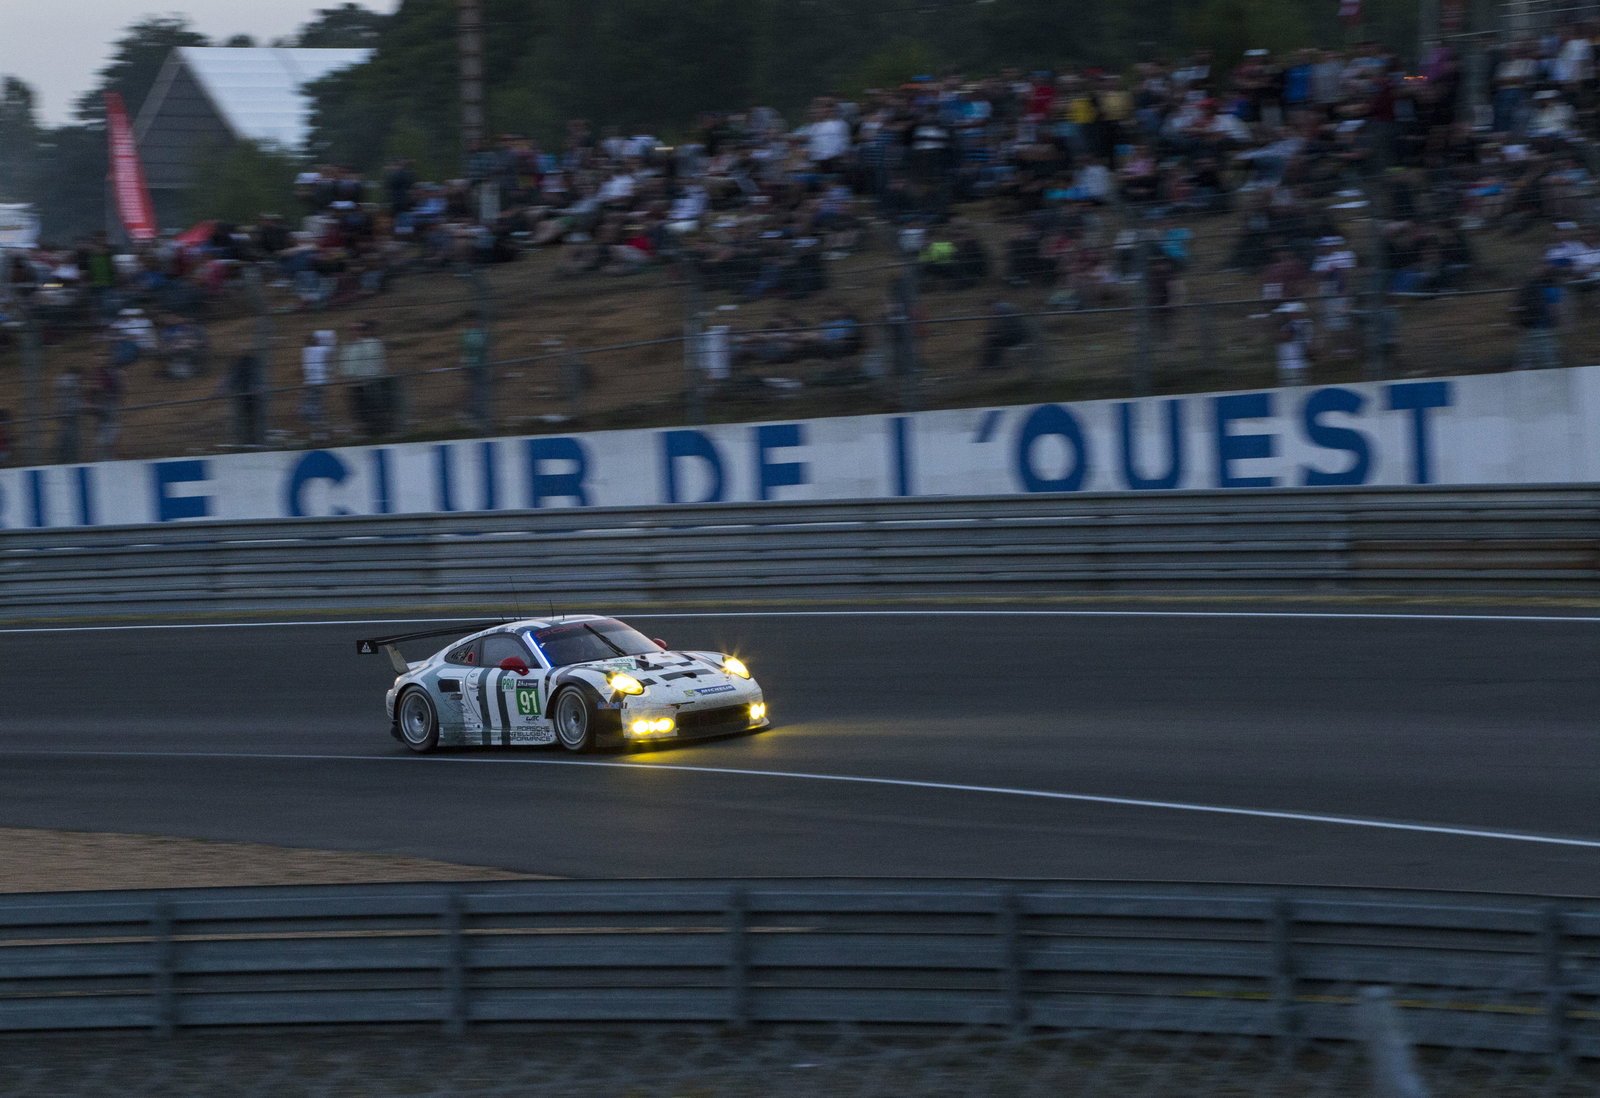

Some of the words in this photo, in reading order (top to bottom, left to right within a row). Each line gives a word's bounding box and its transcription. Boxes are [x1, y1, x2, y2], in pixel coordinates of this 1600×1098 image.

[284, 437, 592, 517] CLUB
[660, 421, 812, 503] DE
[502, 678, 515, 690] PRO
[701, 685, 734, 693] MICHELIN
[520, 690, 538, 714] 91
